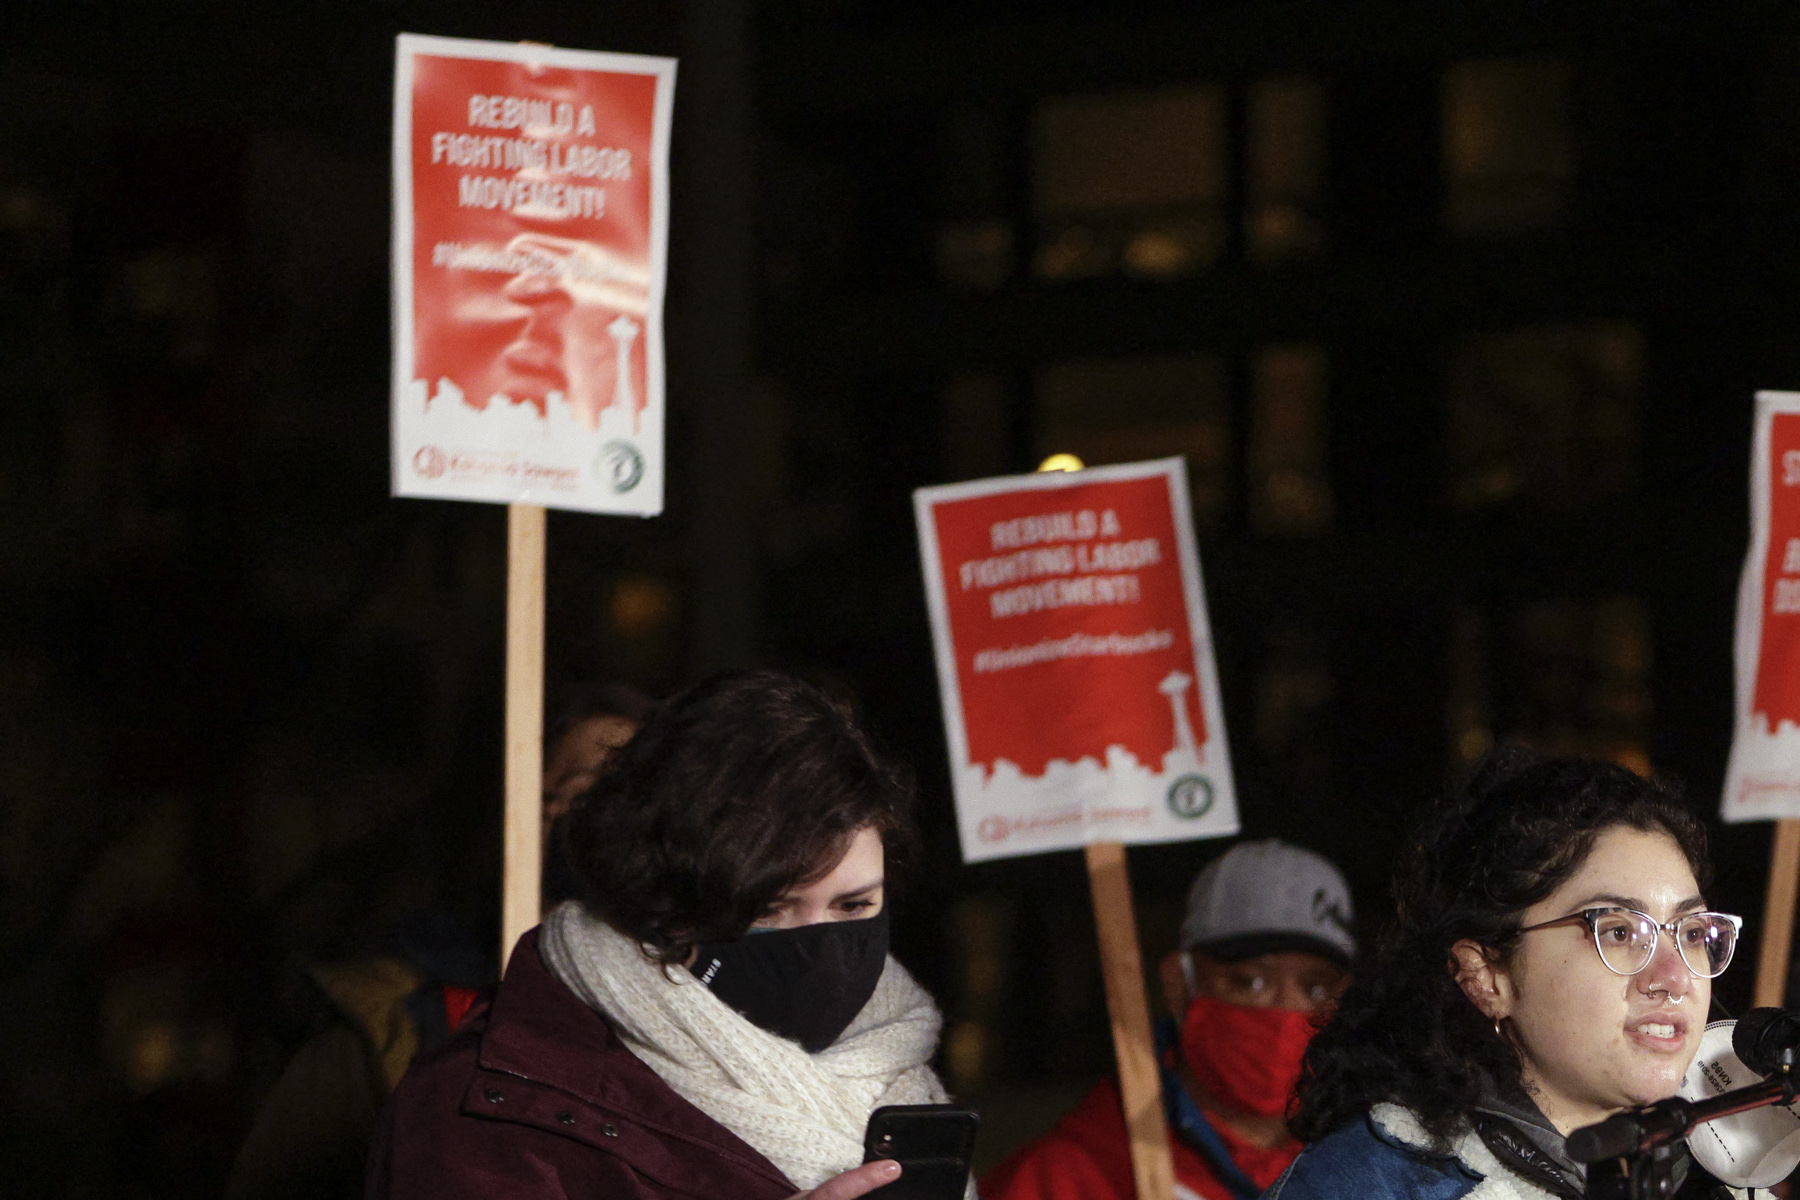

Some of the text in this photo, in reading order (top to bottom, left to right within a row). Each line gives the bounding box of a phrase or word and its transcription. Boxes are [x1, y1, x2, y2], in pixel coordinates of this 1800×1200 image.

[468, 94, 596, 138] REBUILD A
[432, 132, 632, 181] FIGHTING LABOR
[459, 174, 607, 219] MOVEMENT!
[989, 508, 1121, 550] REBUILD A
[959, 538, 1162, 591] FIGHTING LABOR
